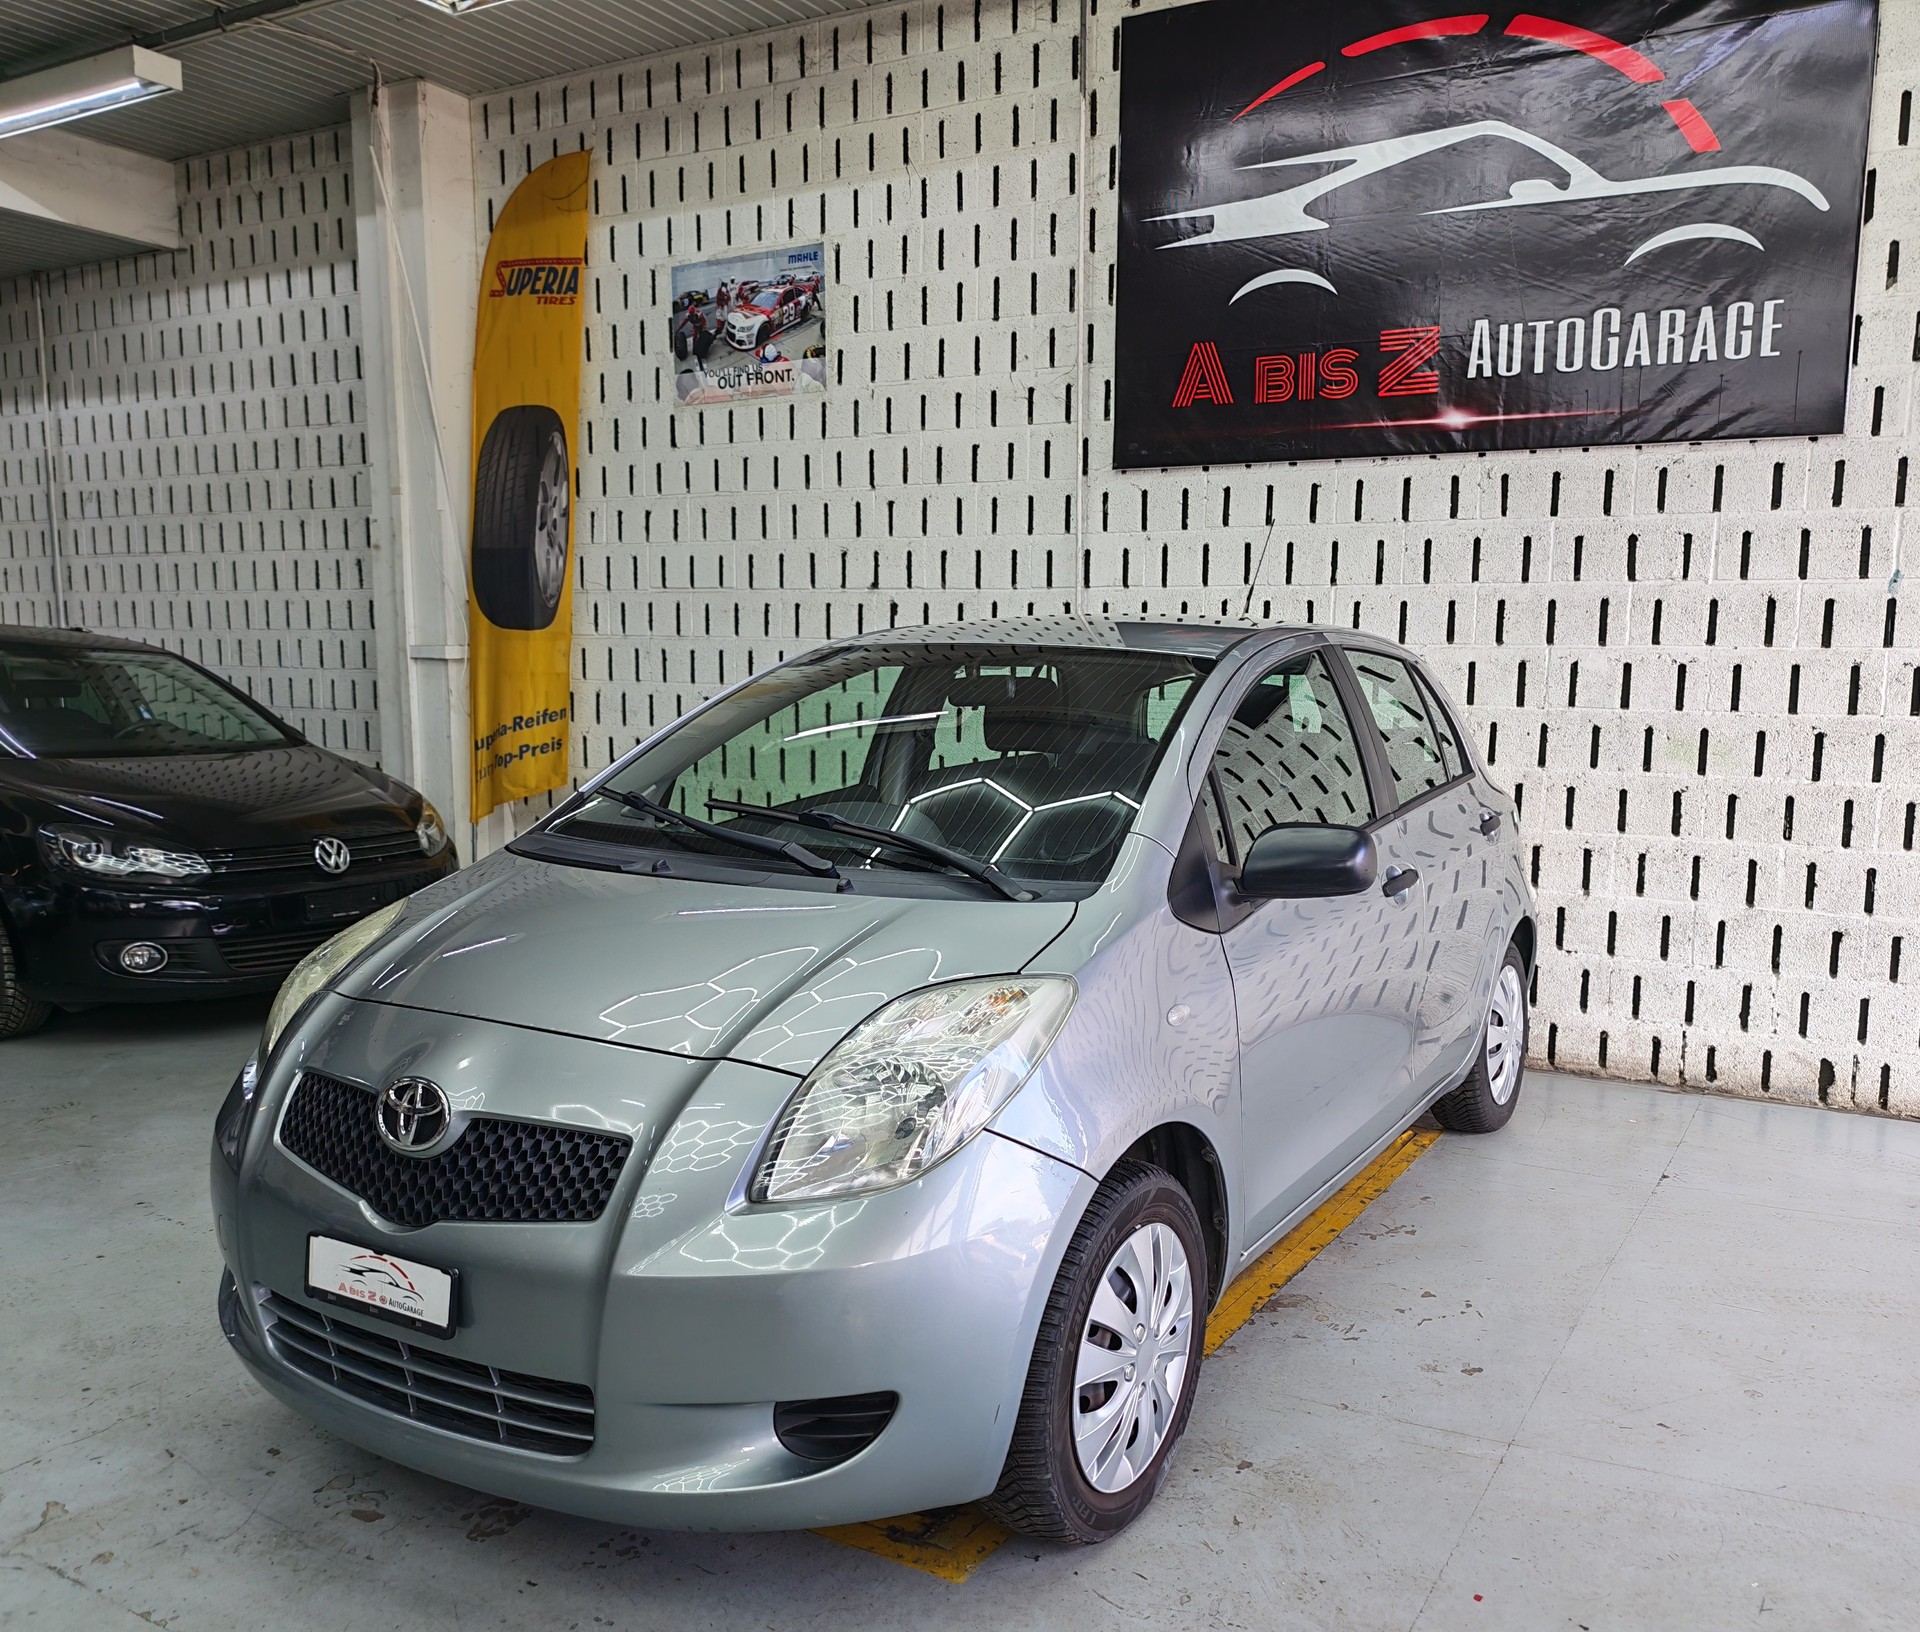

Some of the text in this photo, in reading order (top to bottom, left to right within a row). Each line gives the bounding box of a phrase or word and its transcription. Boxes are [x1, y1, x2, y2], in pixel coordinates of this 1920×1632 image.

[788, 251, 819, 265] MAHLE
[489, 257, 583, 297] SUPERIA
[536, 296, 577, 306] TIRES
[782, 303, 795, 325] 29
[704, 364, 764, 378] YOU'LL FIND US
[1171, 340, 1235, 408] A
[1253, 347, 1360, 403] BIS
[1378, 325, 1441, 398] Z
[717, 368, 795, 390] OUT FRONT.
[338, 1282, 348, 1293] A
[349, 1286, 366, 1299] BIS
[368, 1289, 377, 1302] Z
